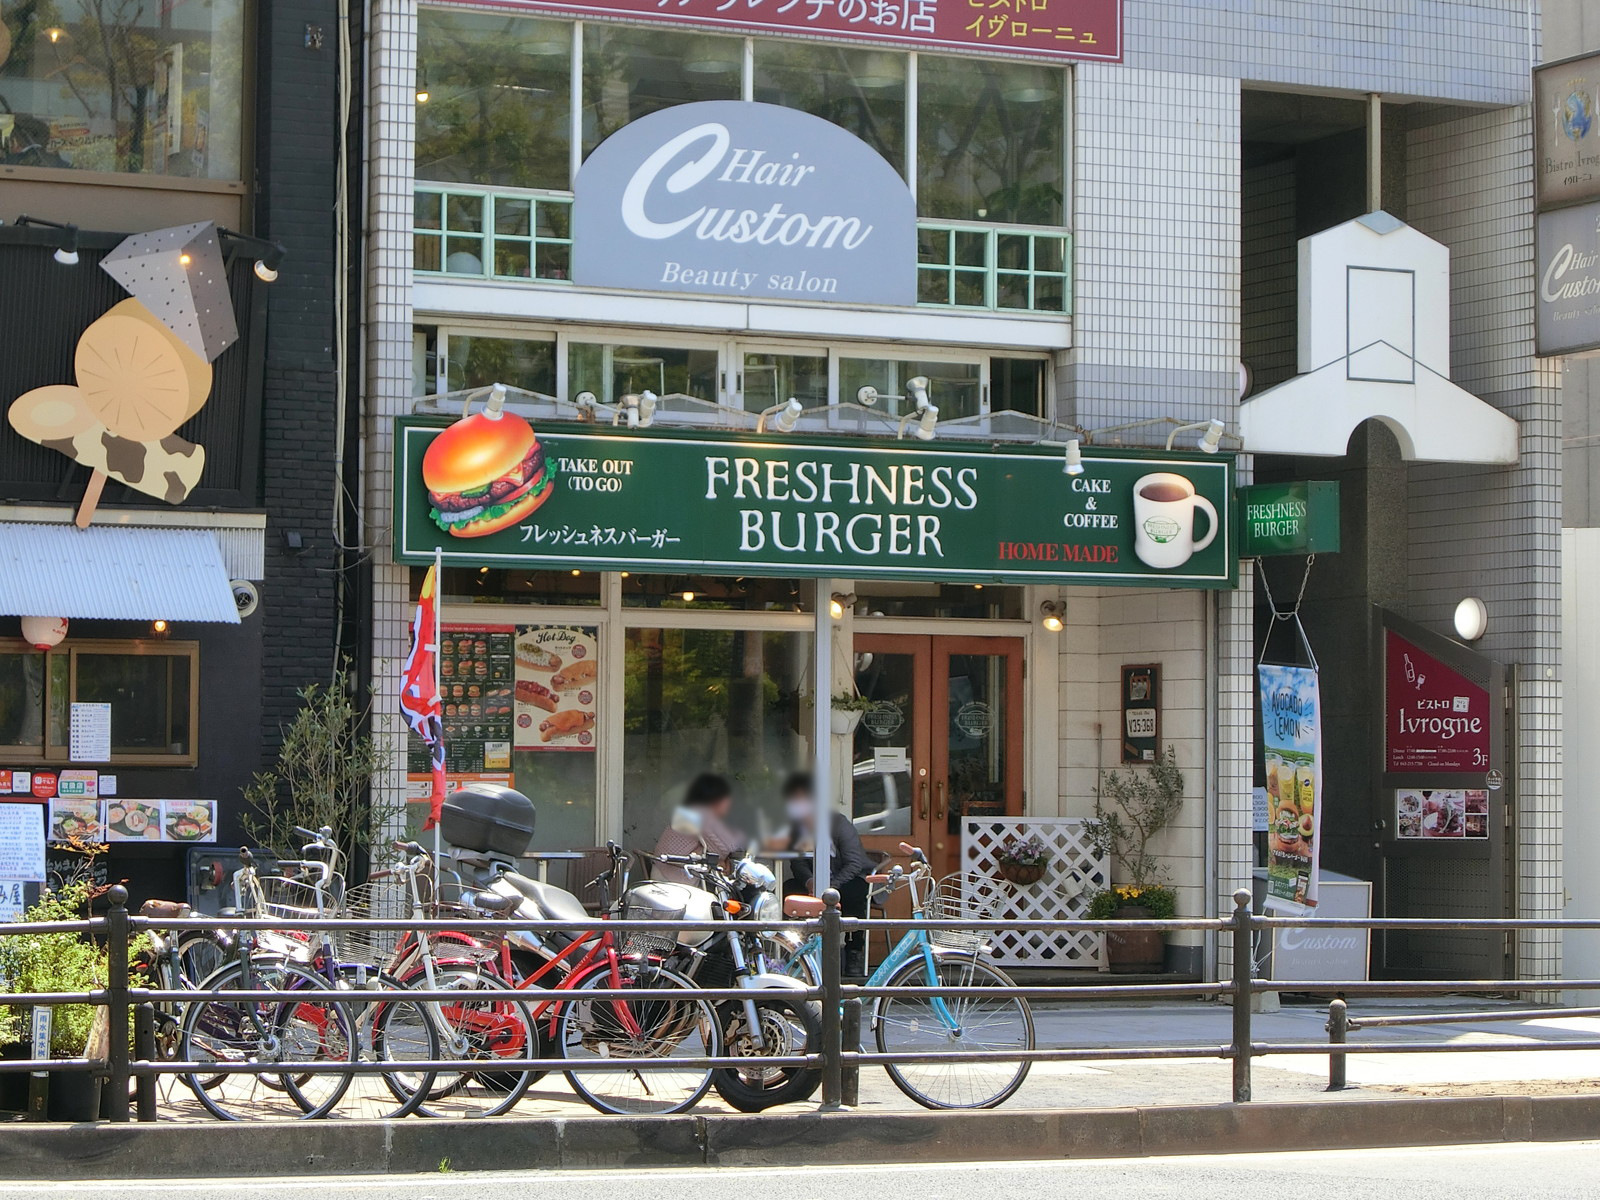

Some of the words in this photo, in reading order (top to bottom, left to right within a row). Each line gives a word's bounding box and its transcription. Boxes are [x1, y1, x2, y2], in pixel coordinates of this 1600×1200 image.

[965, 14, 1097, 44] イヴローニュ
[718, 148, 815, 187] Hair
[1544, 157, 1574, 174] Bistro
[621, 122, 873, 250] Custom
[1569, 249, 1598, 271] Hair
[660, 262, 758, 291] Beauty
[767, 270, 838, 293] salon
[558, 457, 598, 473] TAKE
[602, 460, 633, 475] OUT
[568, 476, 594, 491] (TO
[595, 477, 622, 492] GO)
[704, 456, 979, 510] FRESHNESS
[1071, 478, 1111, 493] CAKE
[1085, 496, 1097, 510] &
[1247, 501, 1307, 520] FRESHNESS
[1063, 513, 1118, 528] COFFEE
[1254, 519, 1299, 538] BURGER
[519, 524, 681, 549] フレッシュネスバーガー
[738, 509, 945, 557] BURGER
[998, 542, 1059, 560] HOME
[1062, 544, 1119, 563] MADE
[536, 631, 556, 644] Hot
[557, 631, 576, 644] Dog
[1272, 691, 1303, 717] AVOCADO
[1417, 699, 1450, 710] ビストロ
[1274, 717, 1301, 741] LEMON
[1399, 707, 1483, 739] Ivrogne
[1472, 747, 1489, 766] 3F
